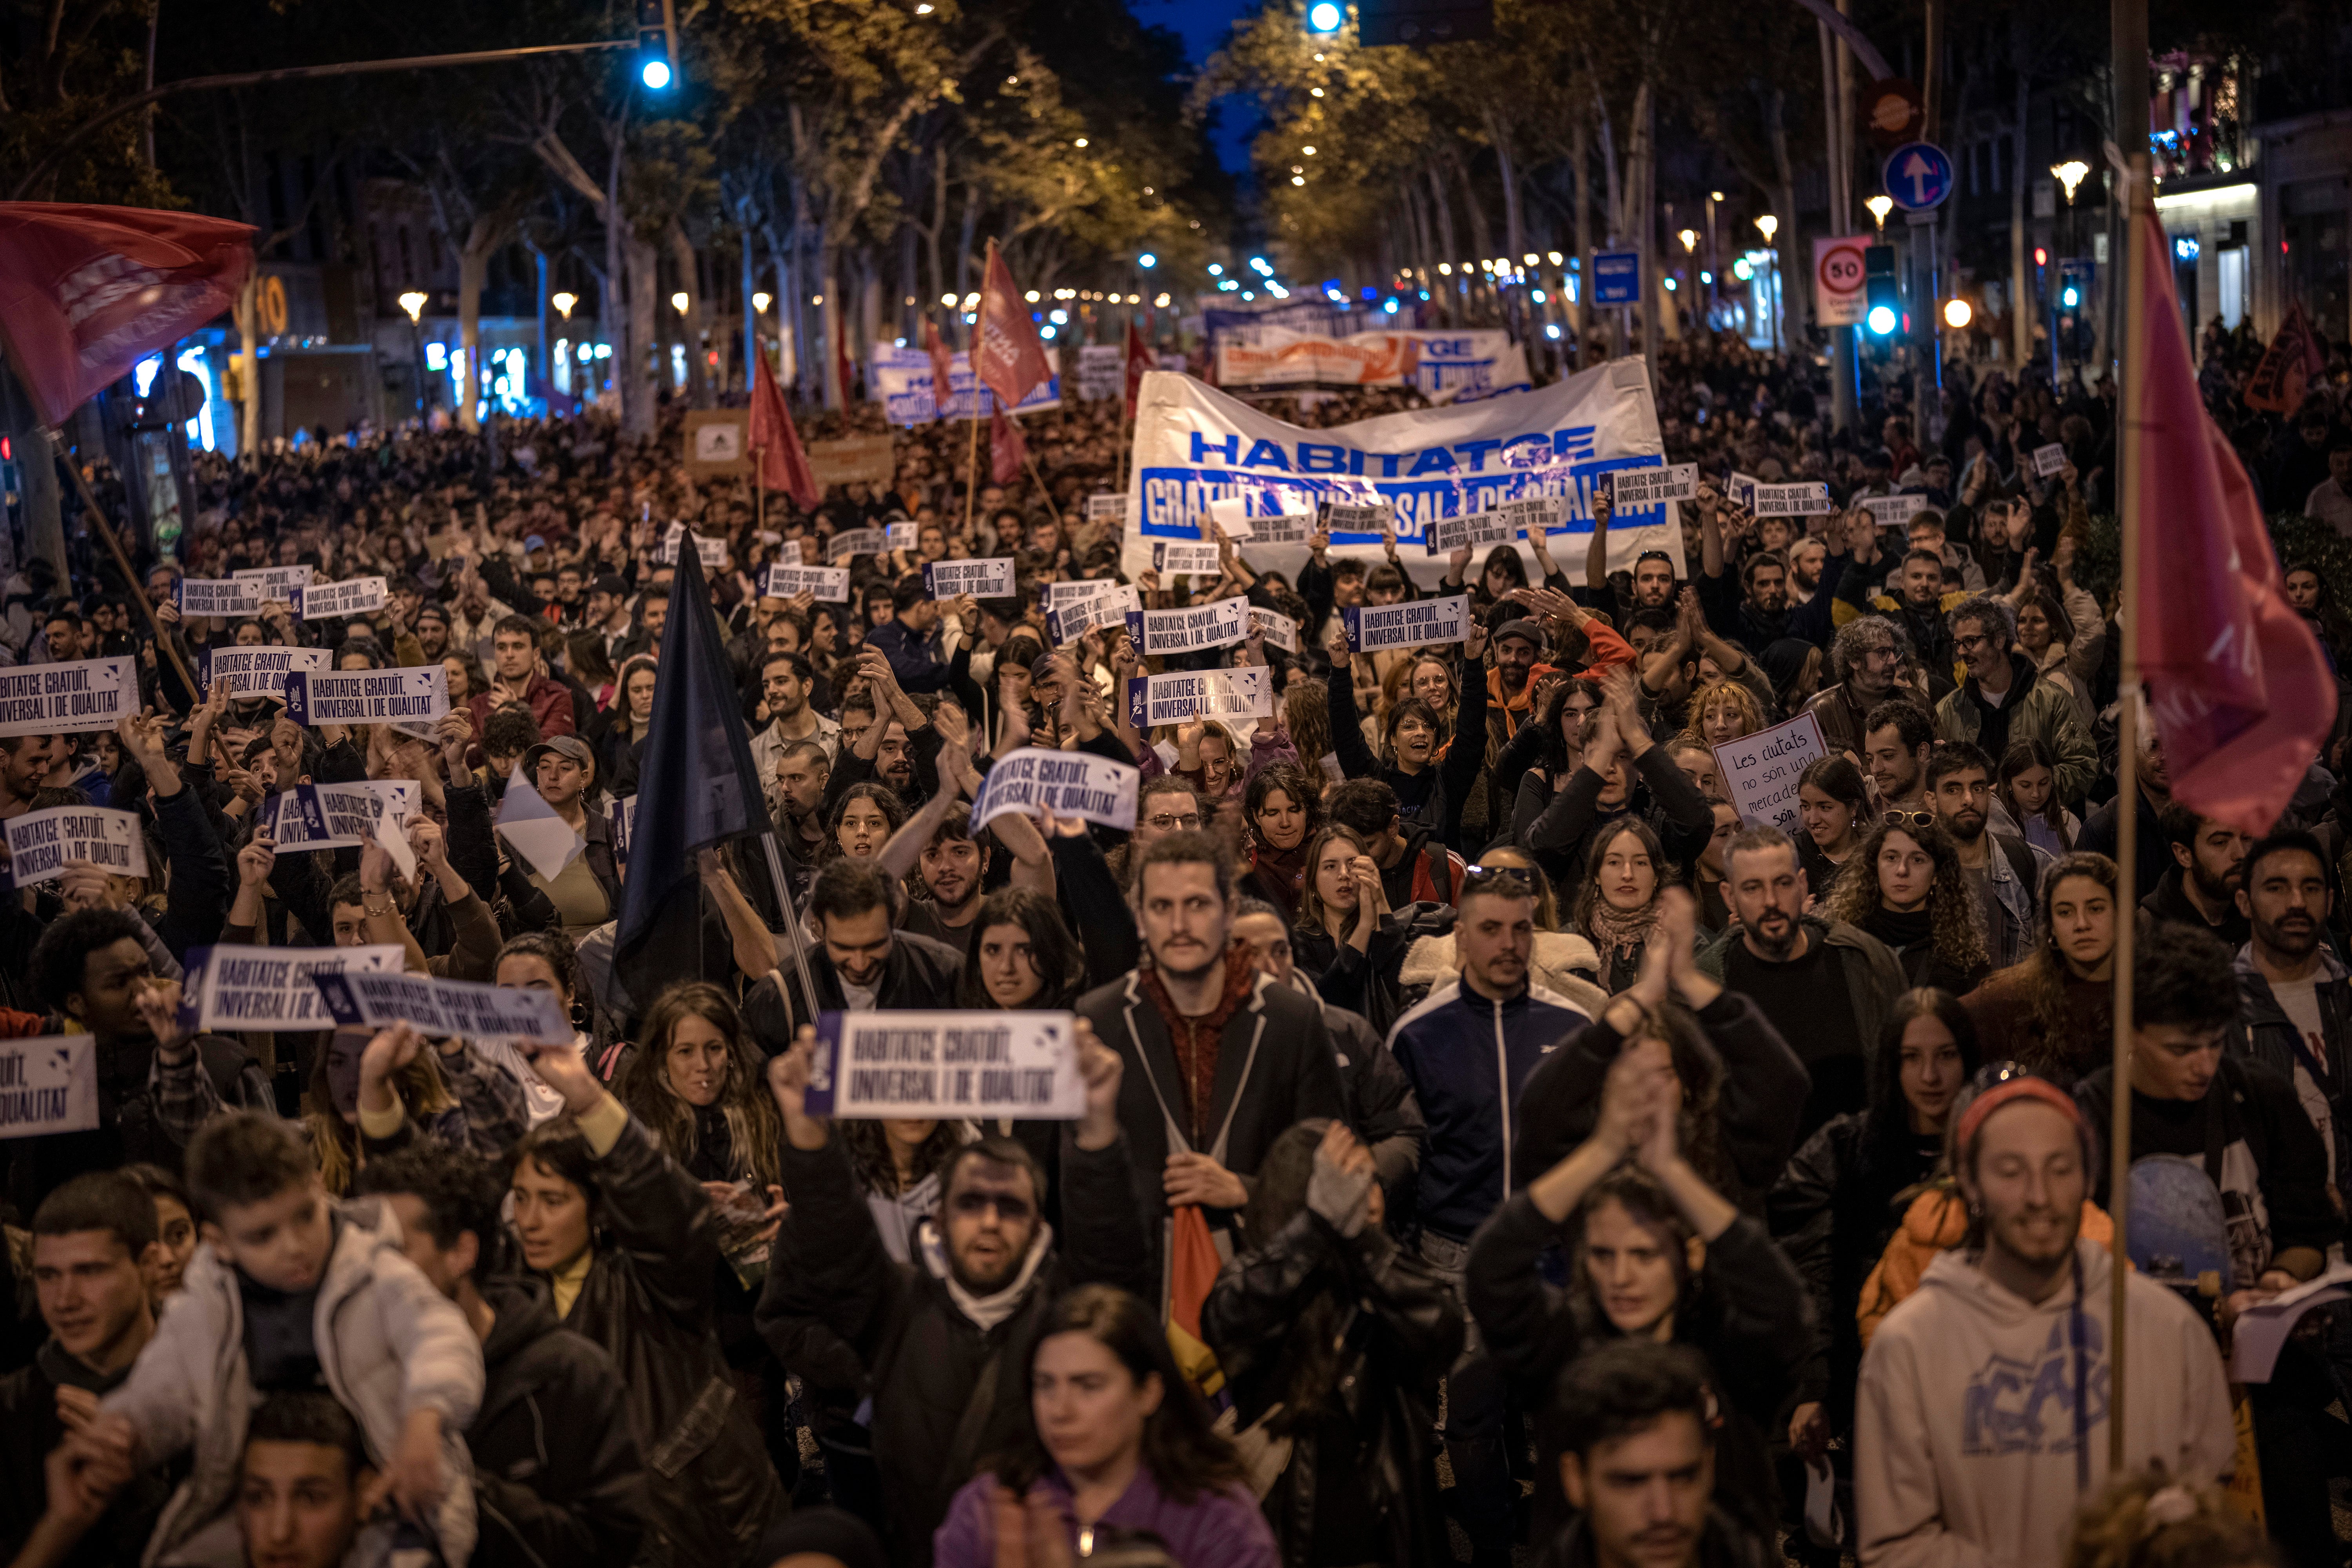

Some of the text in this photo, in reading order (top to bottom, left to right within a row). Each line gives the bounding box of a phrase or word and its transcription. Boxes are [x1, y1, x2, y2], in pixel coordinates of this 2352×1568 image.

[1190, 425, 1597, 477] HABITATGE
[1617, 469, 1674, 489] HABITATGE GRATUÏT,
[1618, 483, 1689, 503] UNIVERSAL I DE QUALITAT
[1759, 489, 1786, 499] HABITATGE
[1759, 499, 1827, 512] UNIVERSAL I DE QUALITAT
[1440, 520, 1466, 536] HABITATGE
[1441, 528, 1506, 550] UNIVERSAL I DE QUALITAT
[935, 565, 961, 581] HABITATGE
[186, 582, 243, 598] HABITATGE GRATUÏT,
[307, 588, 336, 603] HABITATGE
[338, 583, 363, 598] GRATUÏT,
[936, 578, 1004, 596] UNIVERSAL I DE QUALITAT
[186, 598, 259, 612] UNIVERSAL I DE QUALITAT
[307, 593, 377, 615] UNIVERSAL I DE QUALITAT
[1365, 603, 1438, 629] HABITATGE GRATUÏT,
[1148, 607, 1220, 632] HABITATGE GRATUÏT,
[1149, 620, 1239, 649] UNIVERSAL I DE QUALITAT
[1366, 620, 1458, 646] UNIVERSAL I DE QUALITAT
[215, 651, 292, 675] HABITATGE GRATUÏT,
[0, 666, 91, 698] BITATGE GRATUÏT,
[253, 672, 257, 690] I
[258, 672, 269, 690] DE
[313, 679, 362, 697] HABITATGE
[364, 673, 406, 697] GRATUÏT,
[1152, 679, 1196, 699] HABITATGE
[49, 697, 52, 718] I
[55, 695, 68, 717] DE
[71, 690, 119, 716] QUALITAT
[314, 695, 432, 718] UNIVERSAL I DE QUALITAT
[1152, 693, 1256, 719] UNIVERSAL I DE QUALITAT
[1732, 730, 1807, 770] Les ciutats
[991, 757, 1038, 789] HABITATGE
[1742, 779, 1757, 790] no
[1790, 752, 1816, 773] una
[986, 782, 1118, 816] UNIVERSAL I DE QUALITAT
[1748, 783, 1799, 814] mercade
[851, 1028, 939, 1062] HABITATGE
[849, 1067, 1056, 1105] UNIVERSAL I DE QUALITAT
